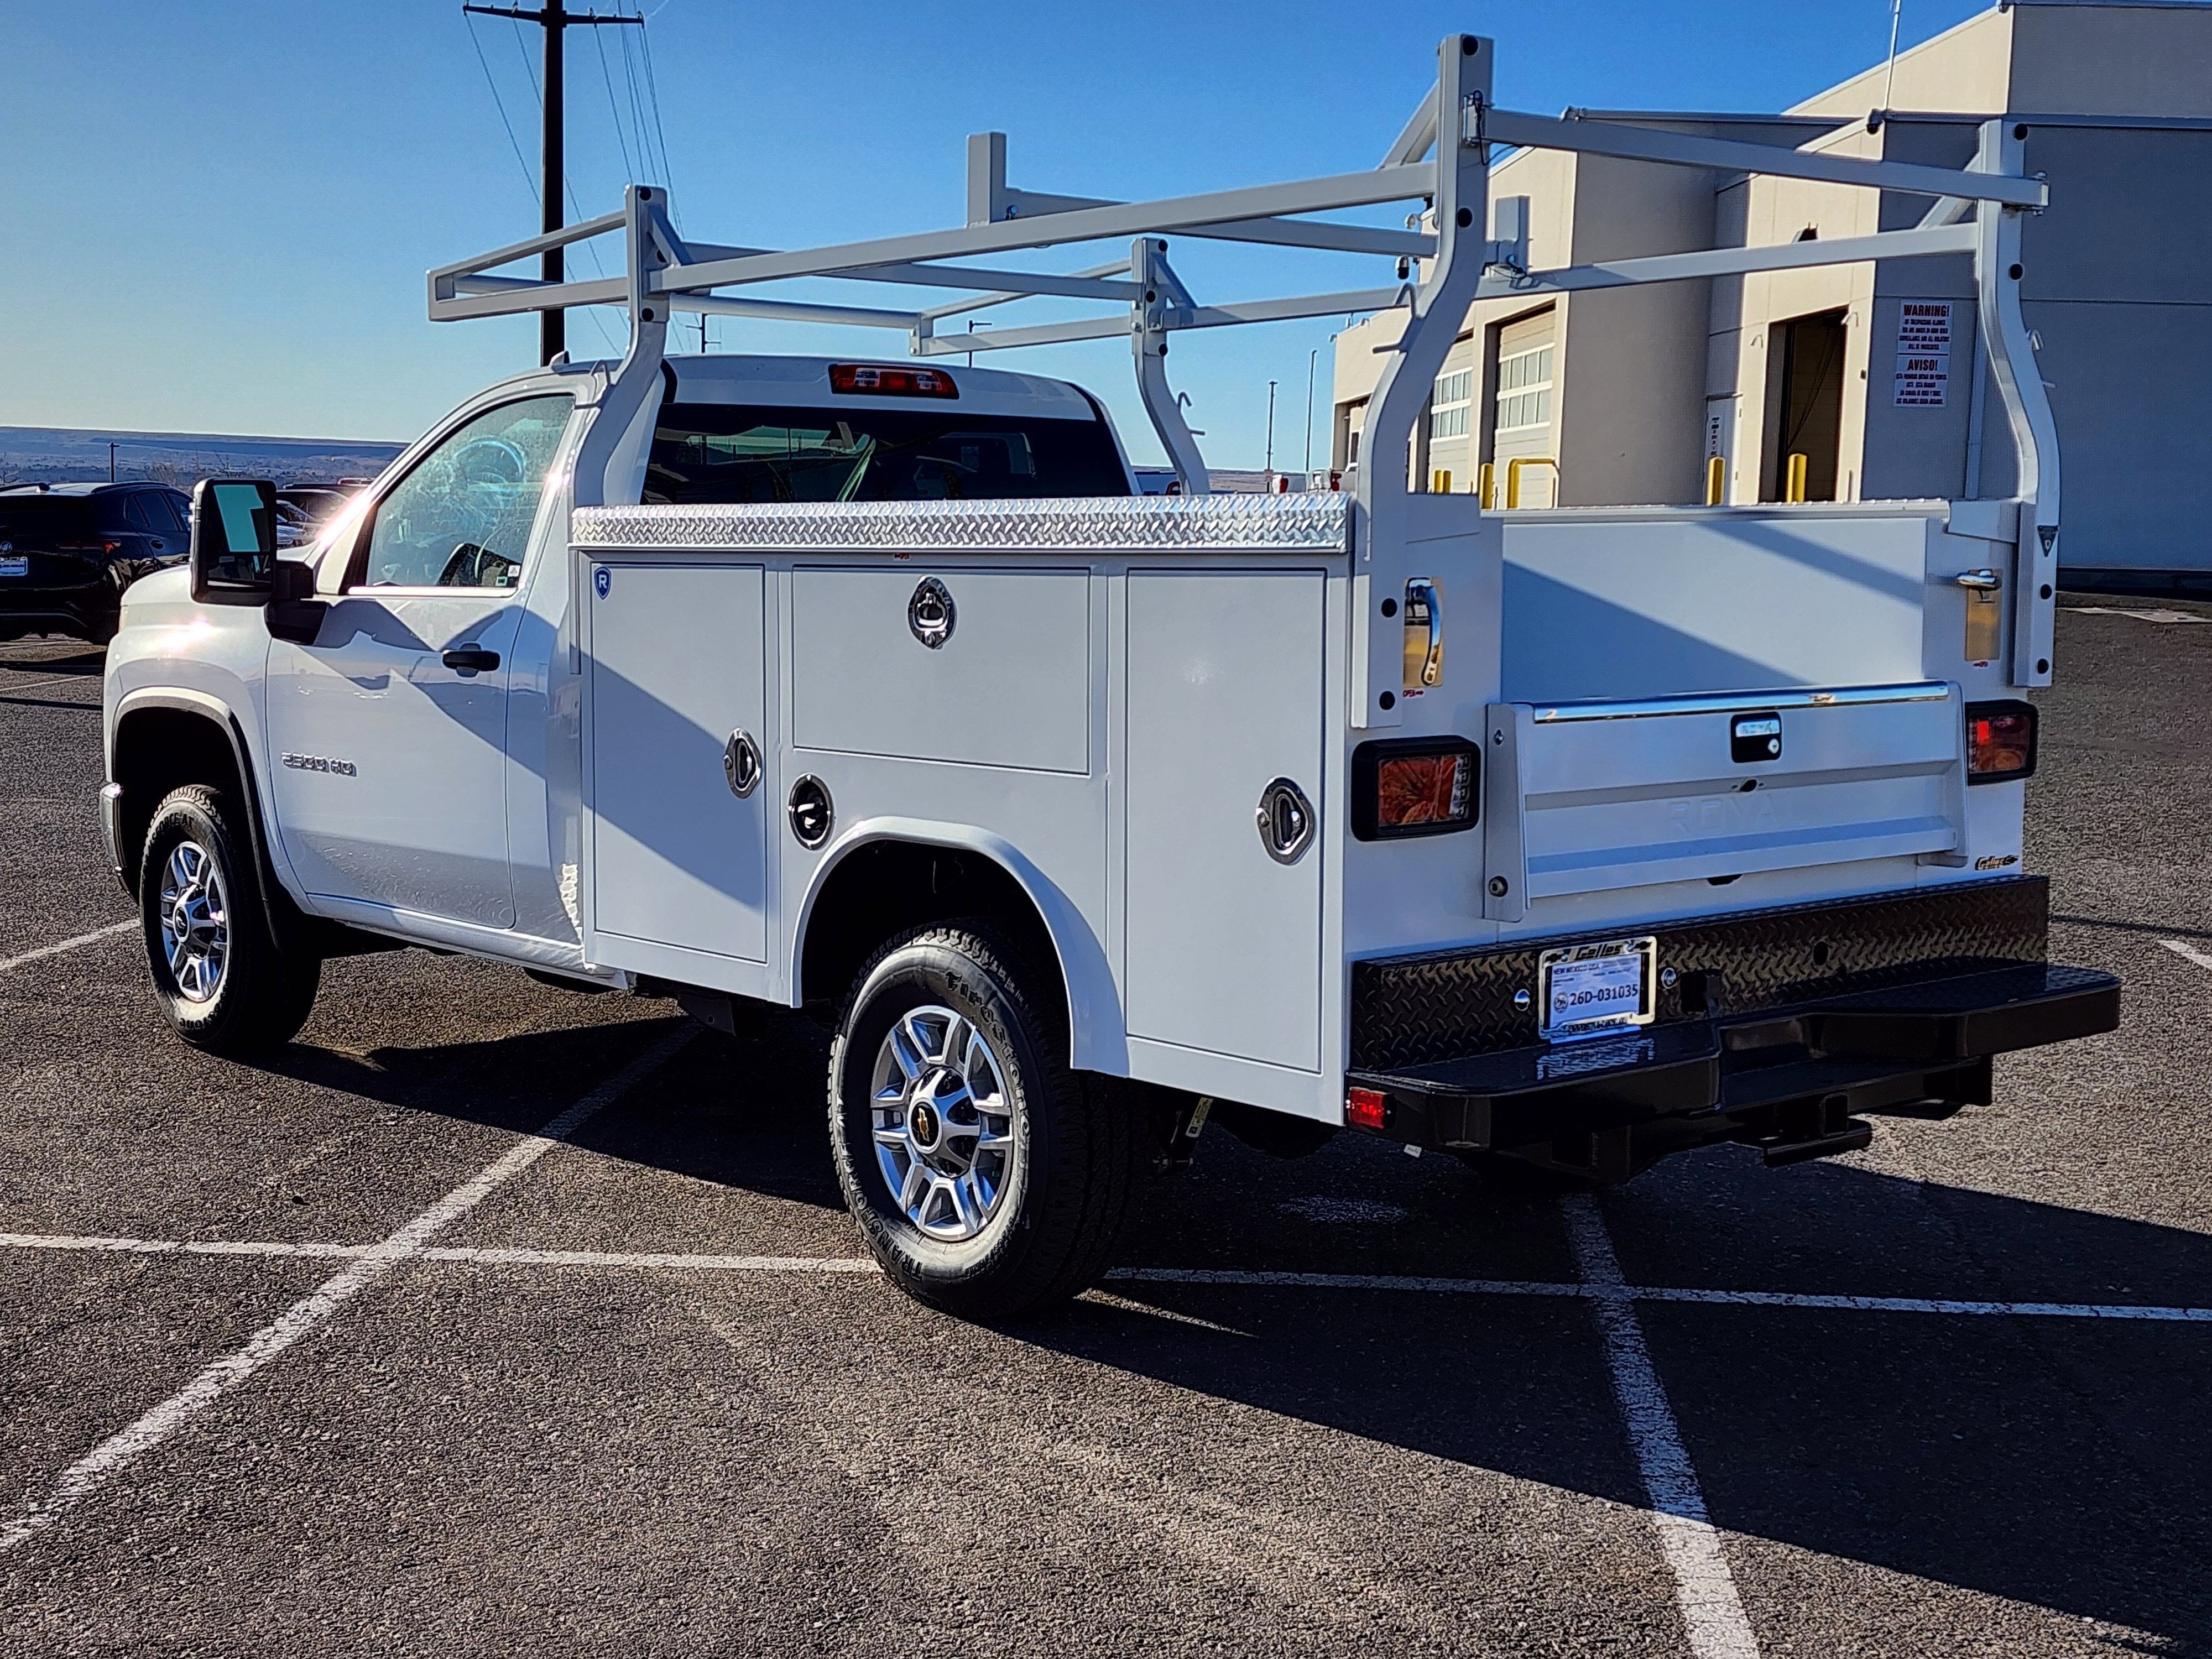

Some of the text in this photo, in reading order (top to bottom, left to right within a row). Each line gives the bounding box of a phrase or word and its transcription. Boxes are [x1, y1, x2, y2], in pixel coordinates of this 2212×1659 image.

[1903, 304, 1950, 317] WARNING!
[1907, 359, 1938, 371] AVISO!
[599, 574, 607, 588] R
[1574, 943, 1624, 961] Galles
[1569, 984, 1639, 1006] 26D-031035
